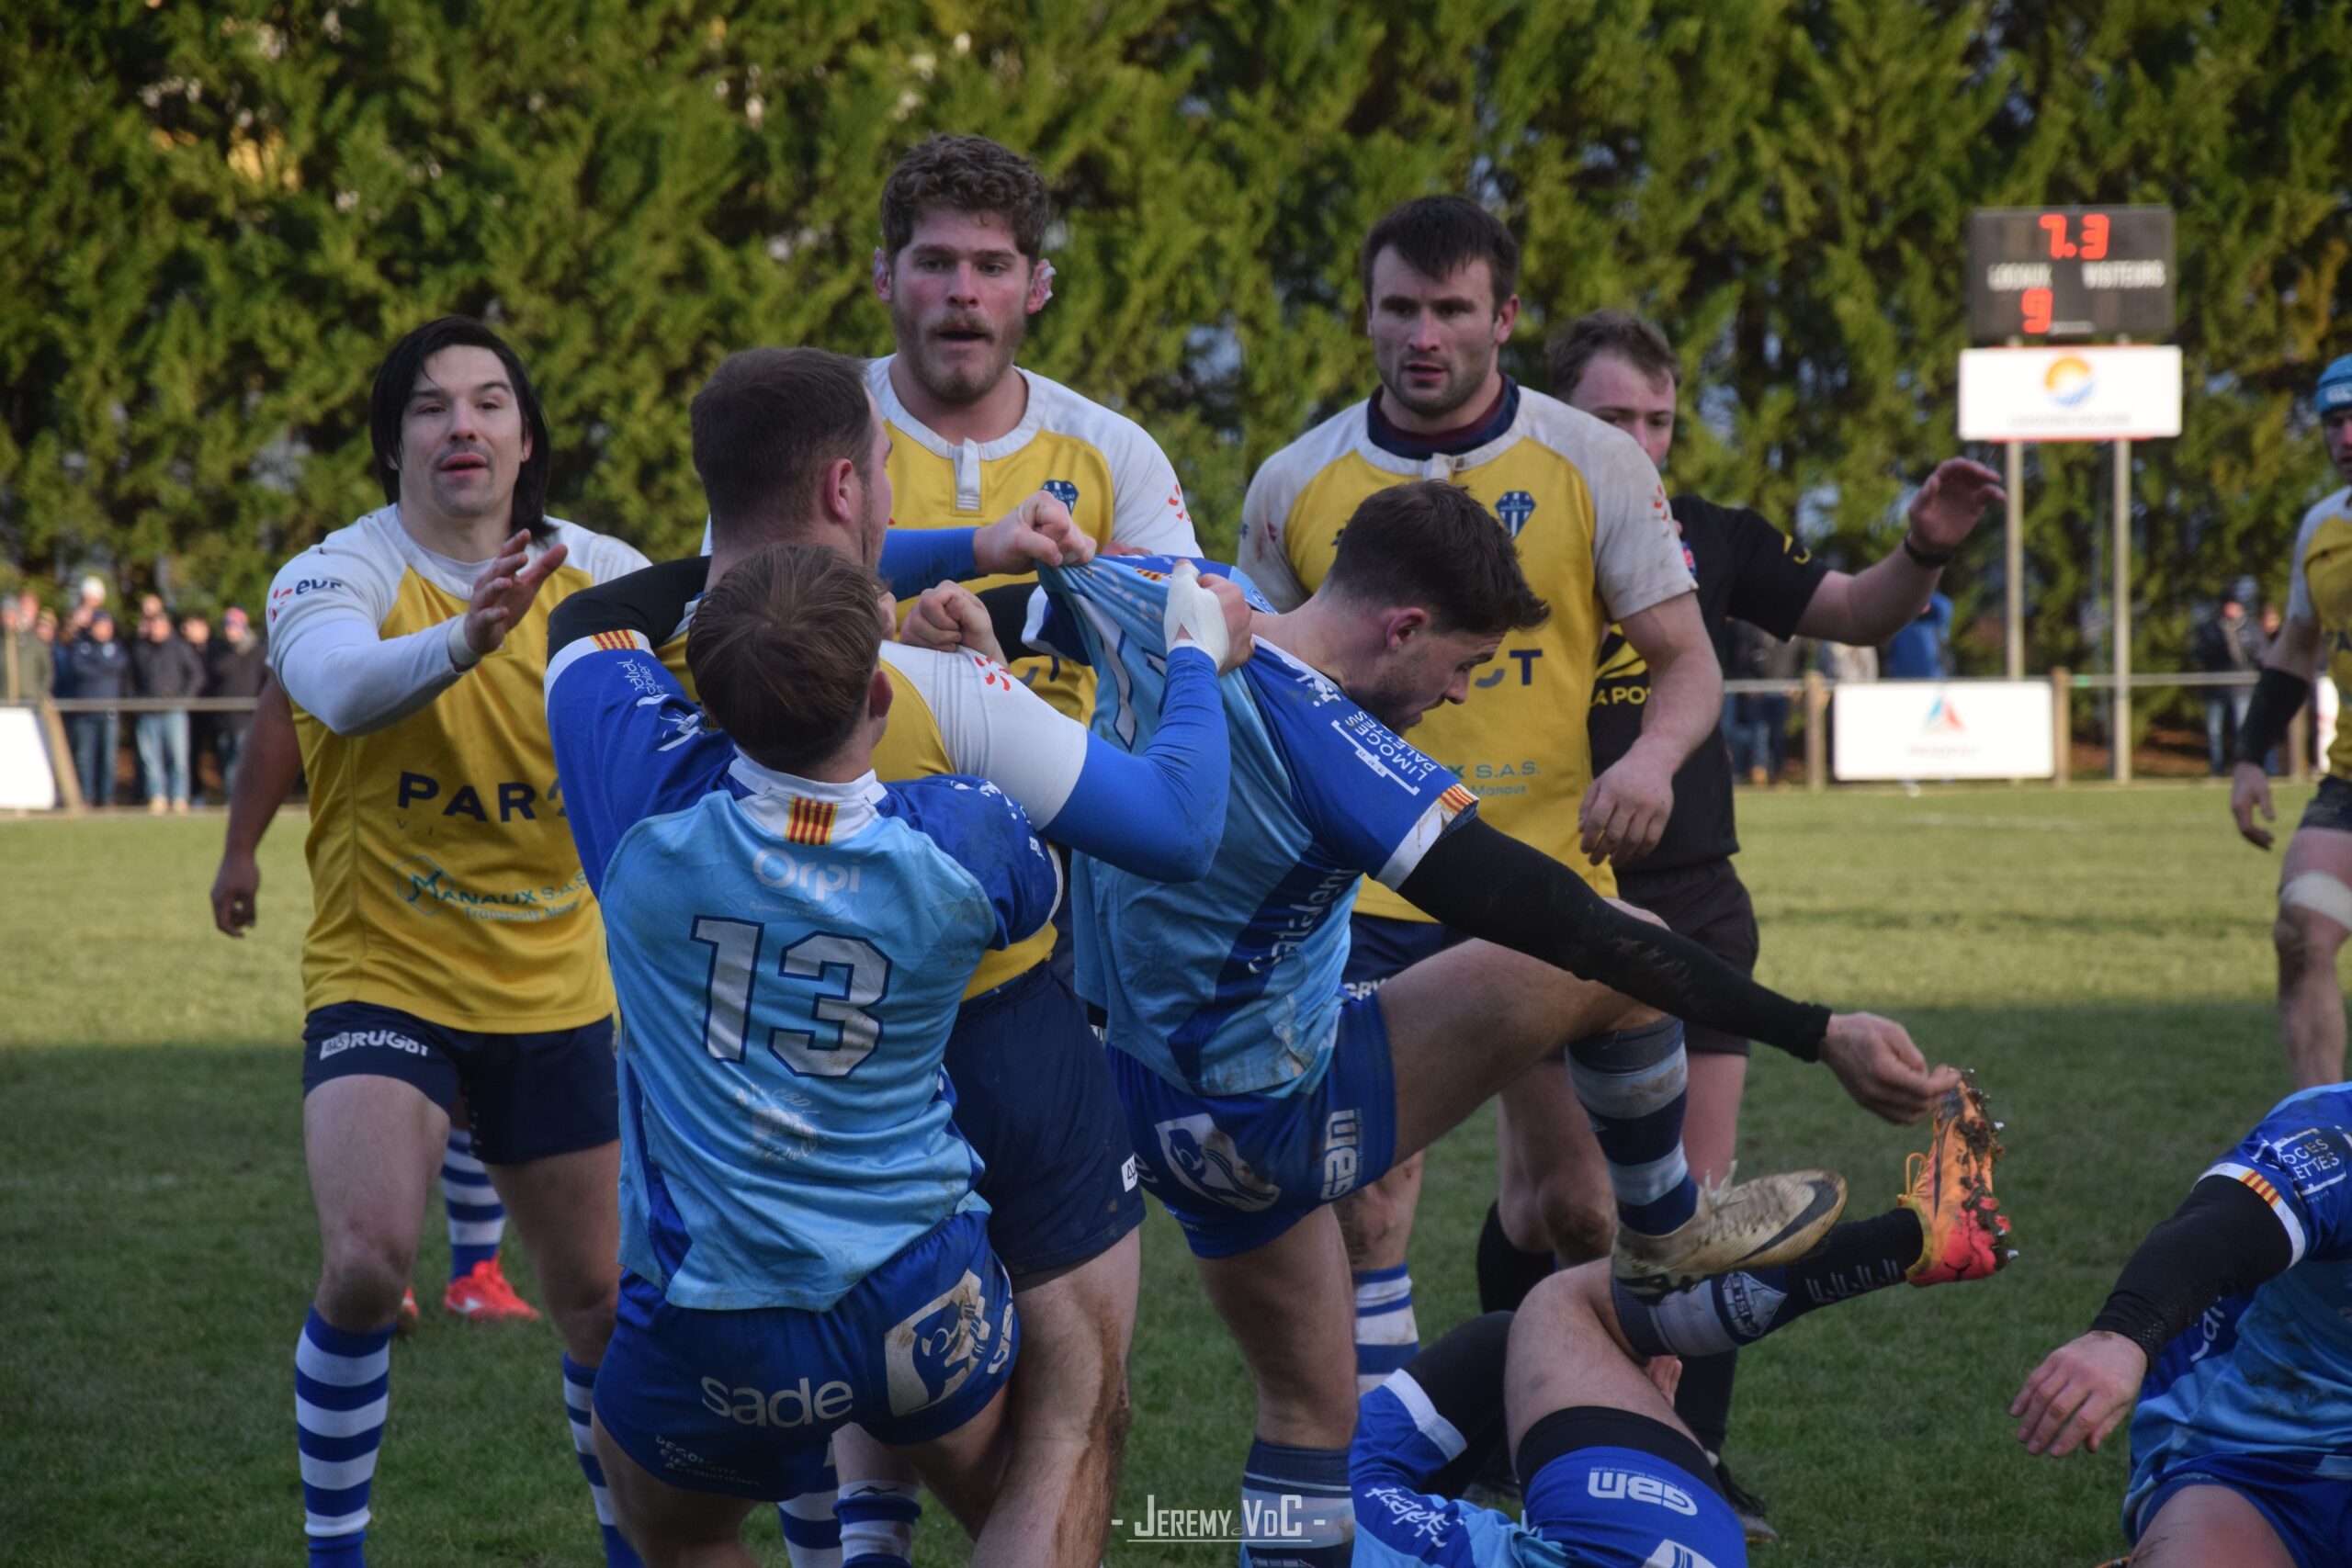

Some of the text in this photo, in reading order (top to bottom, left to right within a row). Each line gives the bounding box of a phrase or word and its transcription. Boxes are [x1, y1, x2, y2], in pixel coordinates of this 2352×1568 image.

[2021, 288, 2053, 333] 9
[753, 848, 861, 902] Orpi
[689, 914, 893, 1078] 13
[701, 1376, 854, 1428] sade
